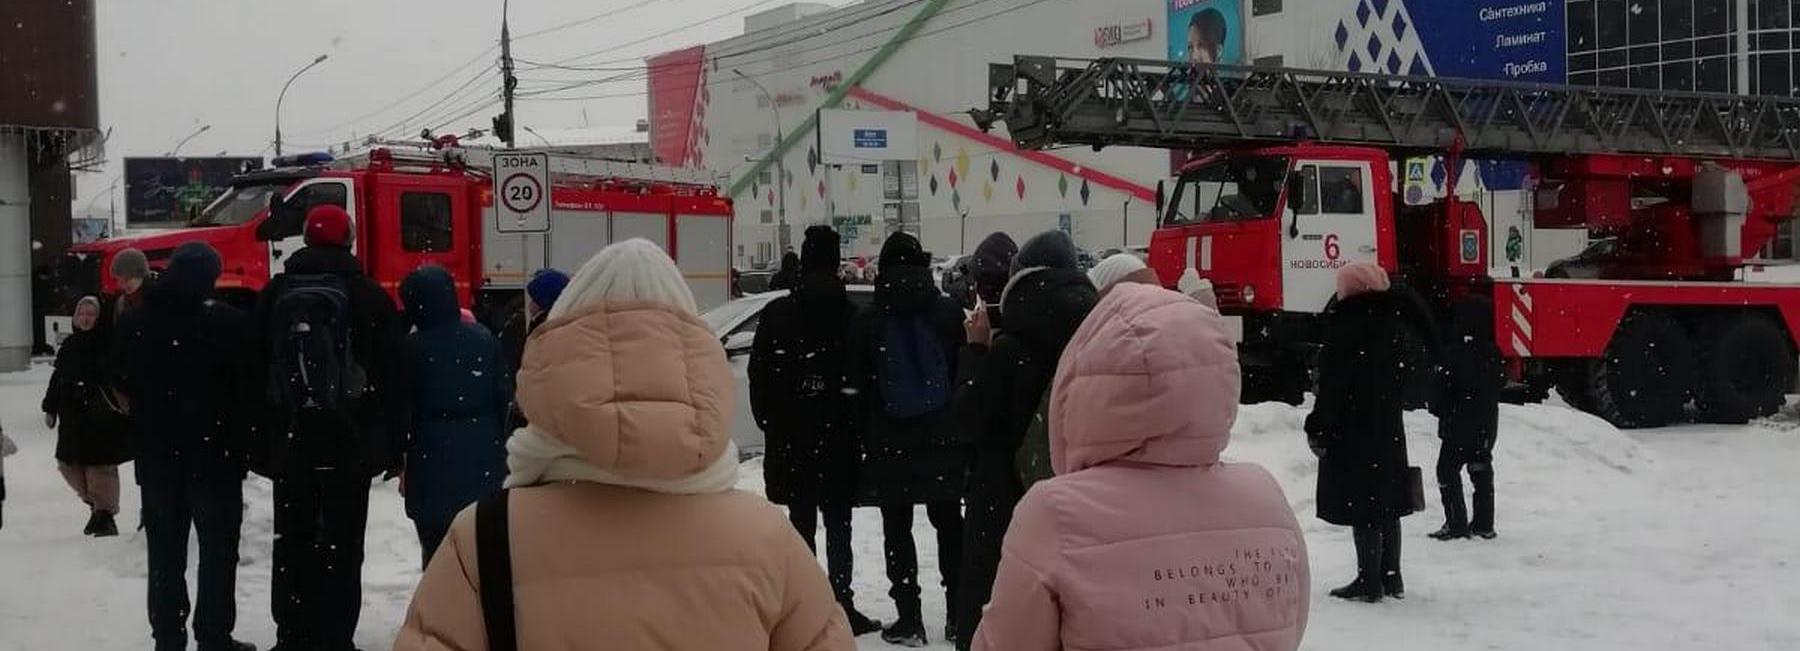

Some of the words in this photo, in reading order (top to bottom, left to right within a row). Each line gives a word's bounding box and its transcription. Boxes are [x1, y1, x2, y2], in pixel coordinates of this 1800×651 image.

[1479, 1, 1546, 21] Сантехника
[1495, 31, 1546, 48] Ламинат
[1505, 59, 1547, 77] Пробка
[502, 156, 538, 168] ЗОНА
[510, 185, 533, 201] 20
[1324, 234, 1340, 259] 6
[1153, 563, 1236, 581] BELONGS
[1187, 588, 1250, 606] BEAUTY
